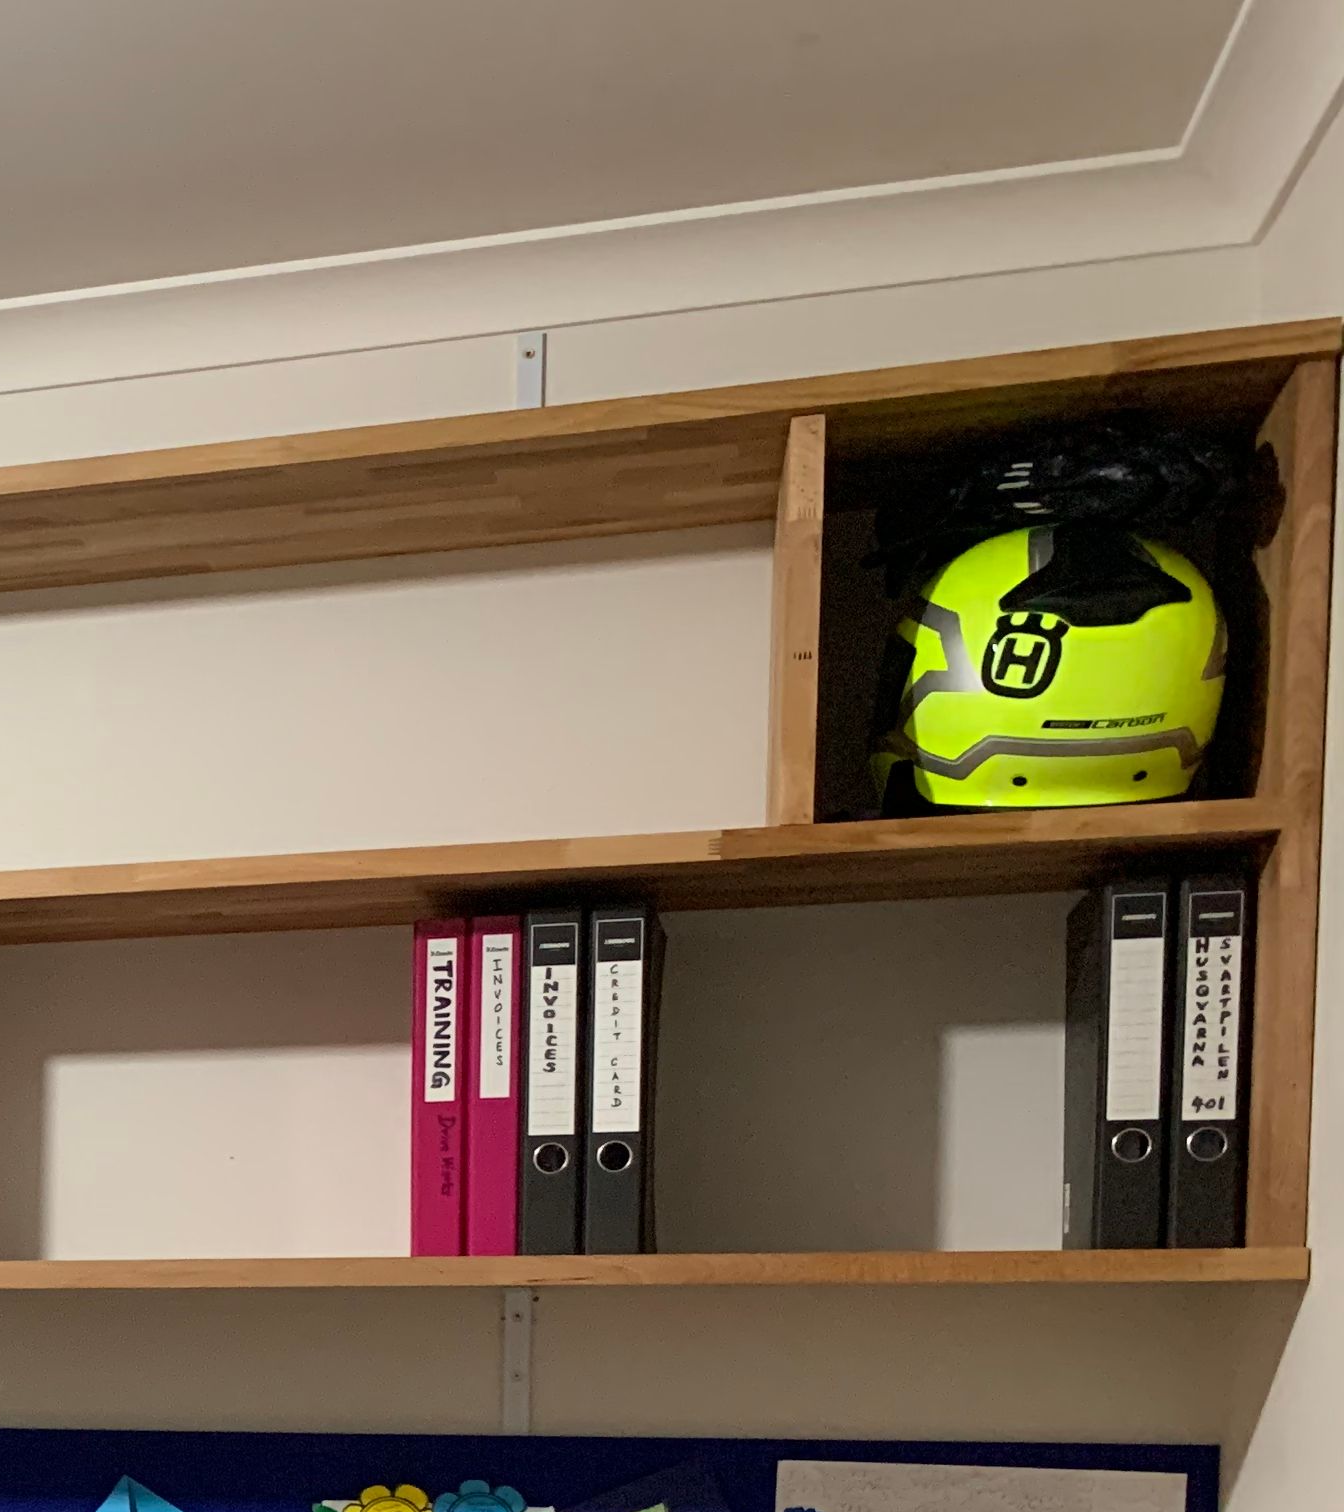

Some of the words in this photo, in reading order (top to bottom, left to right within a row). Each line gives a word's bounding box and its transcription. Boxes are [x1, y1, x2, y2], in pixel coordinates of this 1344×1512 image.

[430, 960, 453, 1089] TRAINING
[492, 958, 504, 1066] INVOICES
[543, 967, 559, 1073] INVOICES
[609, 964, 621, 1040] CREDIT
[1192, 938, 1210, 1067] HUSQVARNA
[1217, 937, 1232, 1080] SVARTPILEN
[610, 1057, 622, 1107] CARD
[1191, 1096, 1224, 1113] 401
